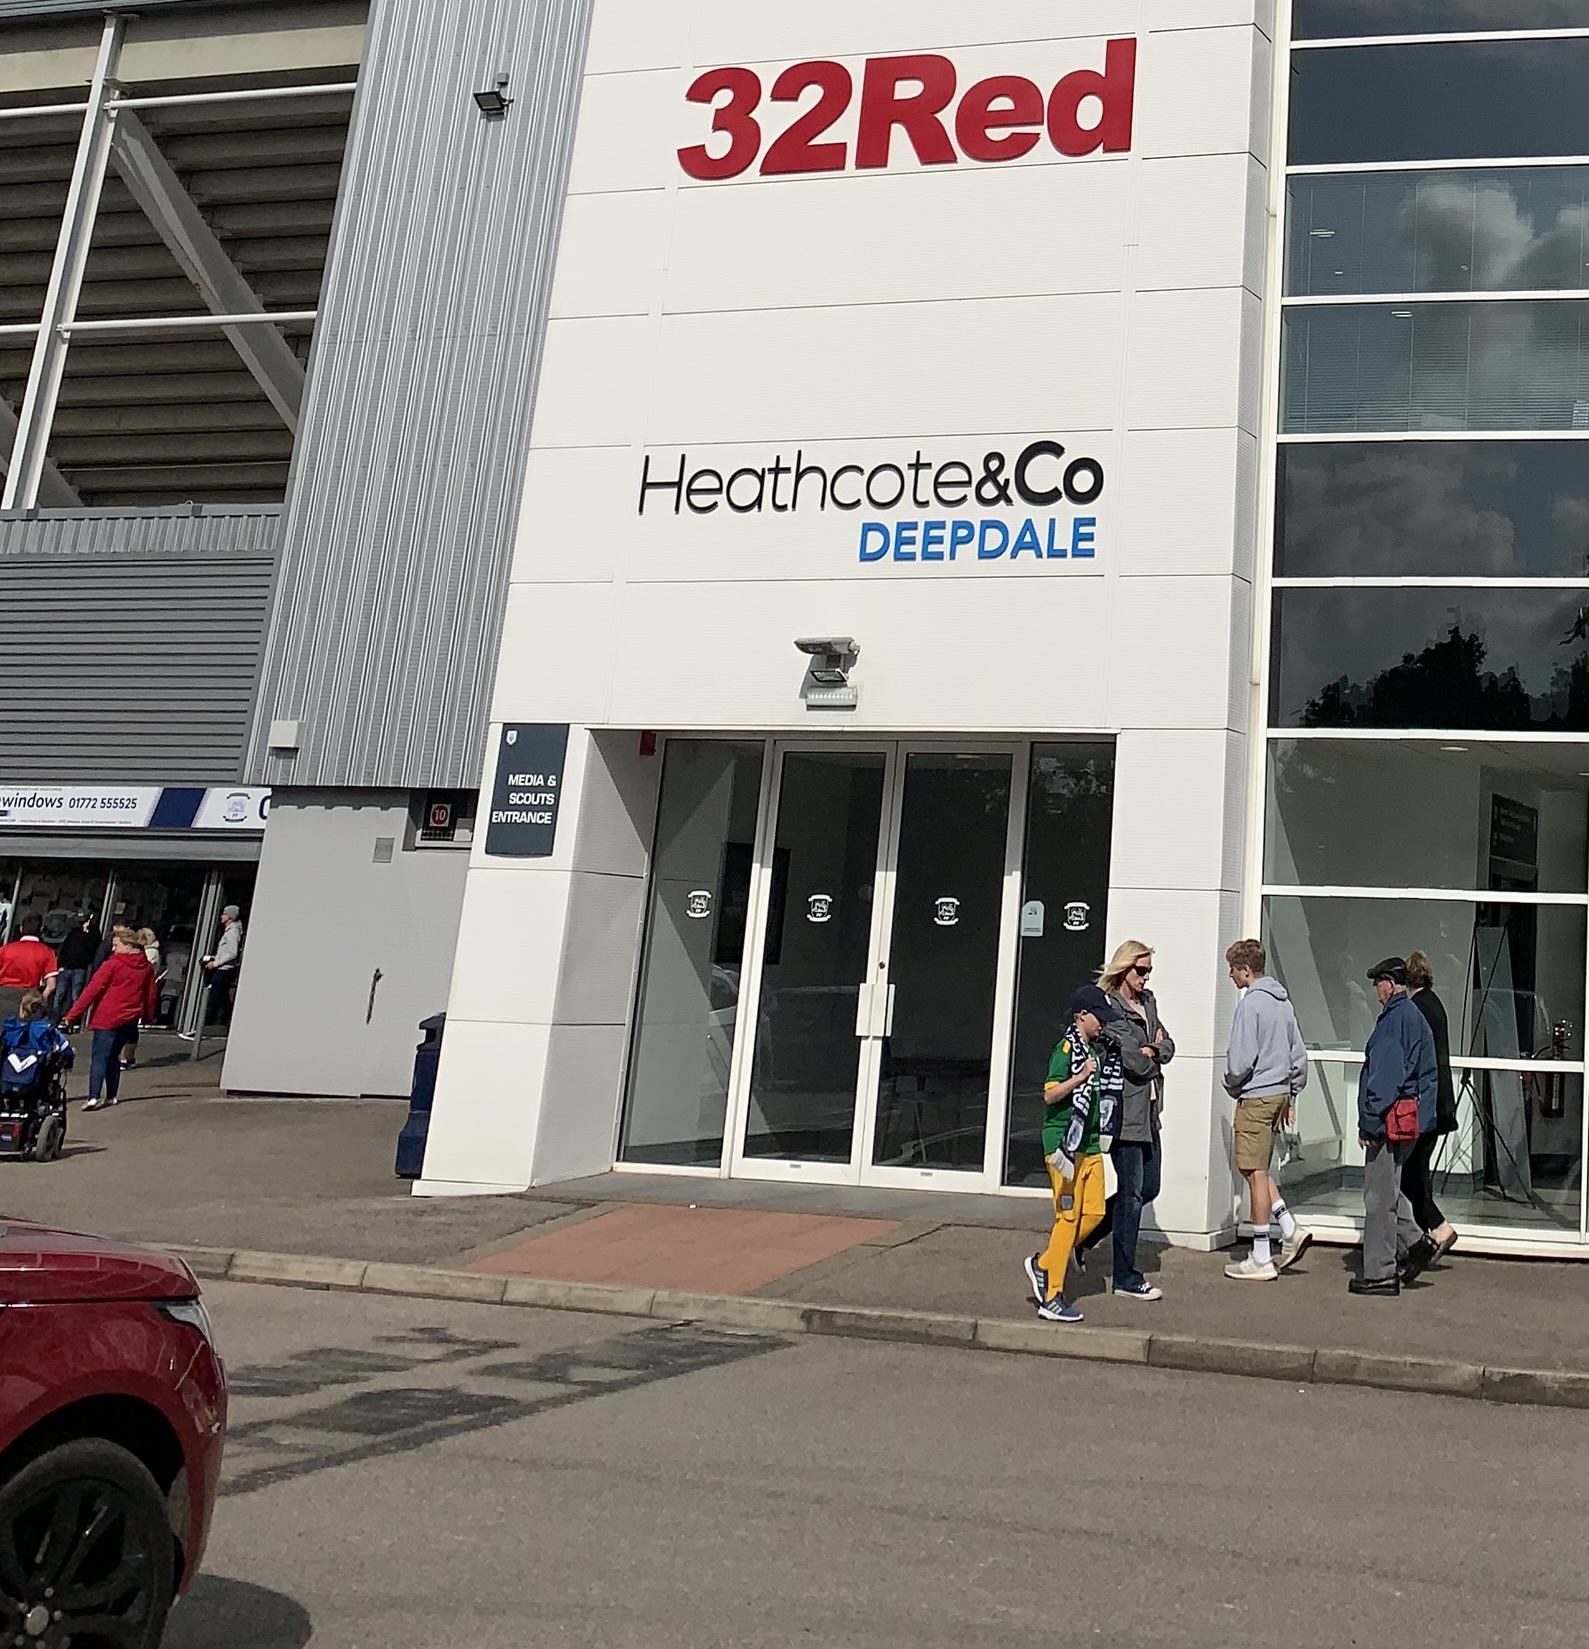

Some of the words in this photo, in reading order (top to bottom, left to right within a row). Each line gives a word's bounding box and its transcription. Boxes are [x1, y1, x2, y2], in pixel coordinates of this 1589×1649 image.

[676, 37, 1138, 182] 32Red
[638, 440, 1105, 516] Heathcote&Co
[858, 516, 1097, 563] DEEPDALE
[507, 774, 545, 786] MEDIA
[547, 775, 557, 786] &
[0, 792, 64, 808] windows
[68, 797, 98, 809] 01772
[99, 797, 138, 810] 555525
[508, 792, 555, 806] SCOUTS
[434, 809, 446, 821] 10
[491, 811, 553, 824] ENTRANCE
